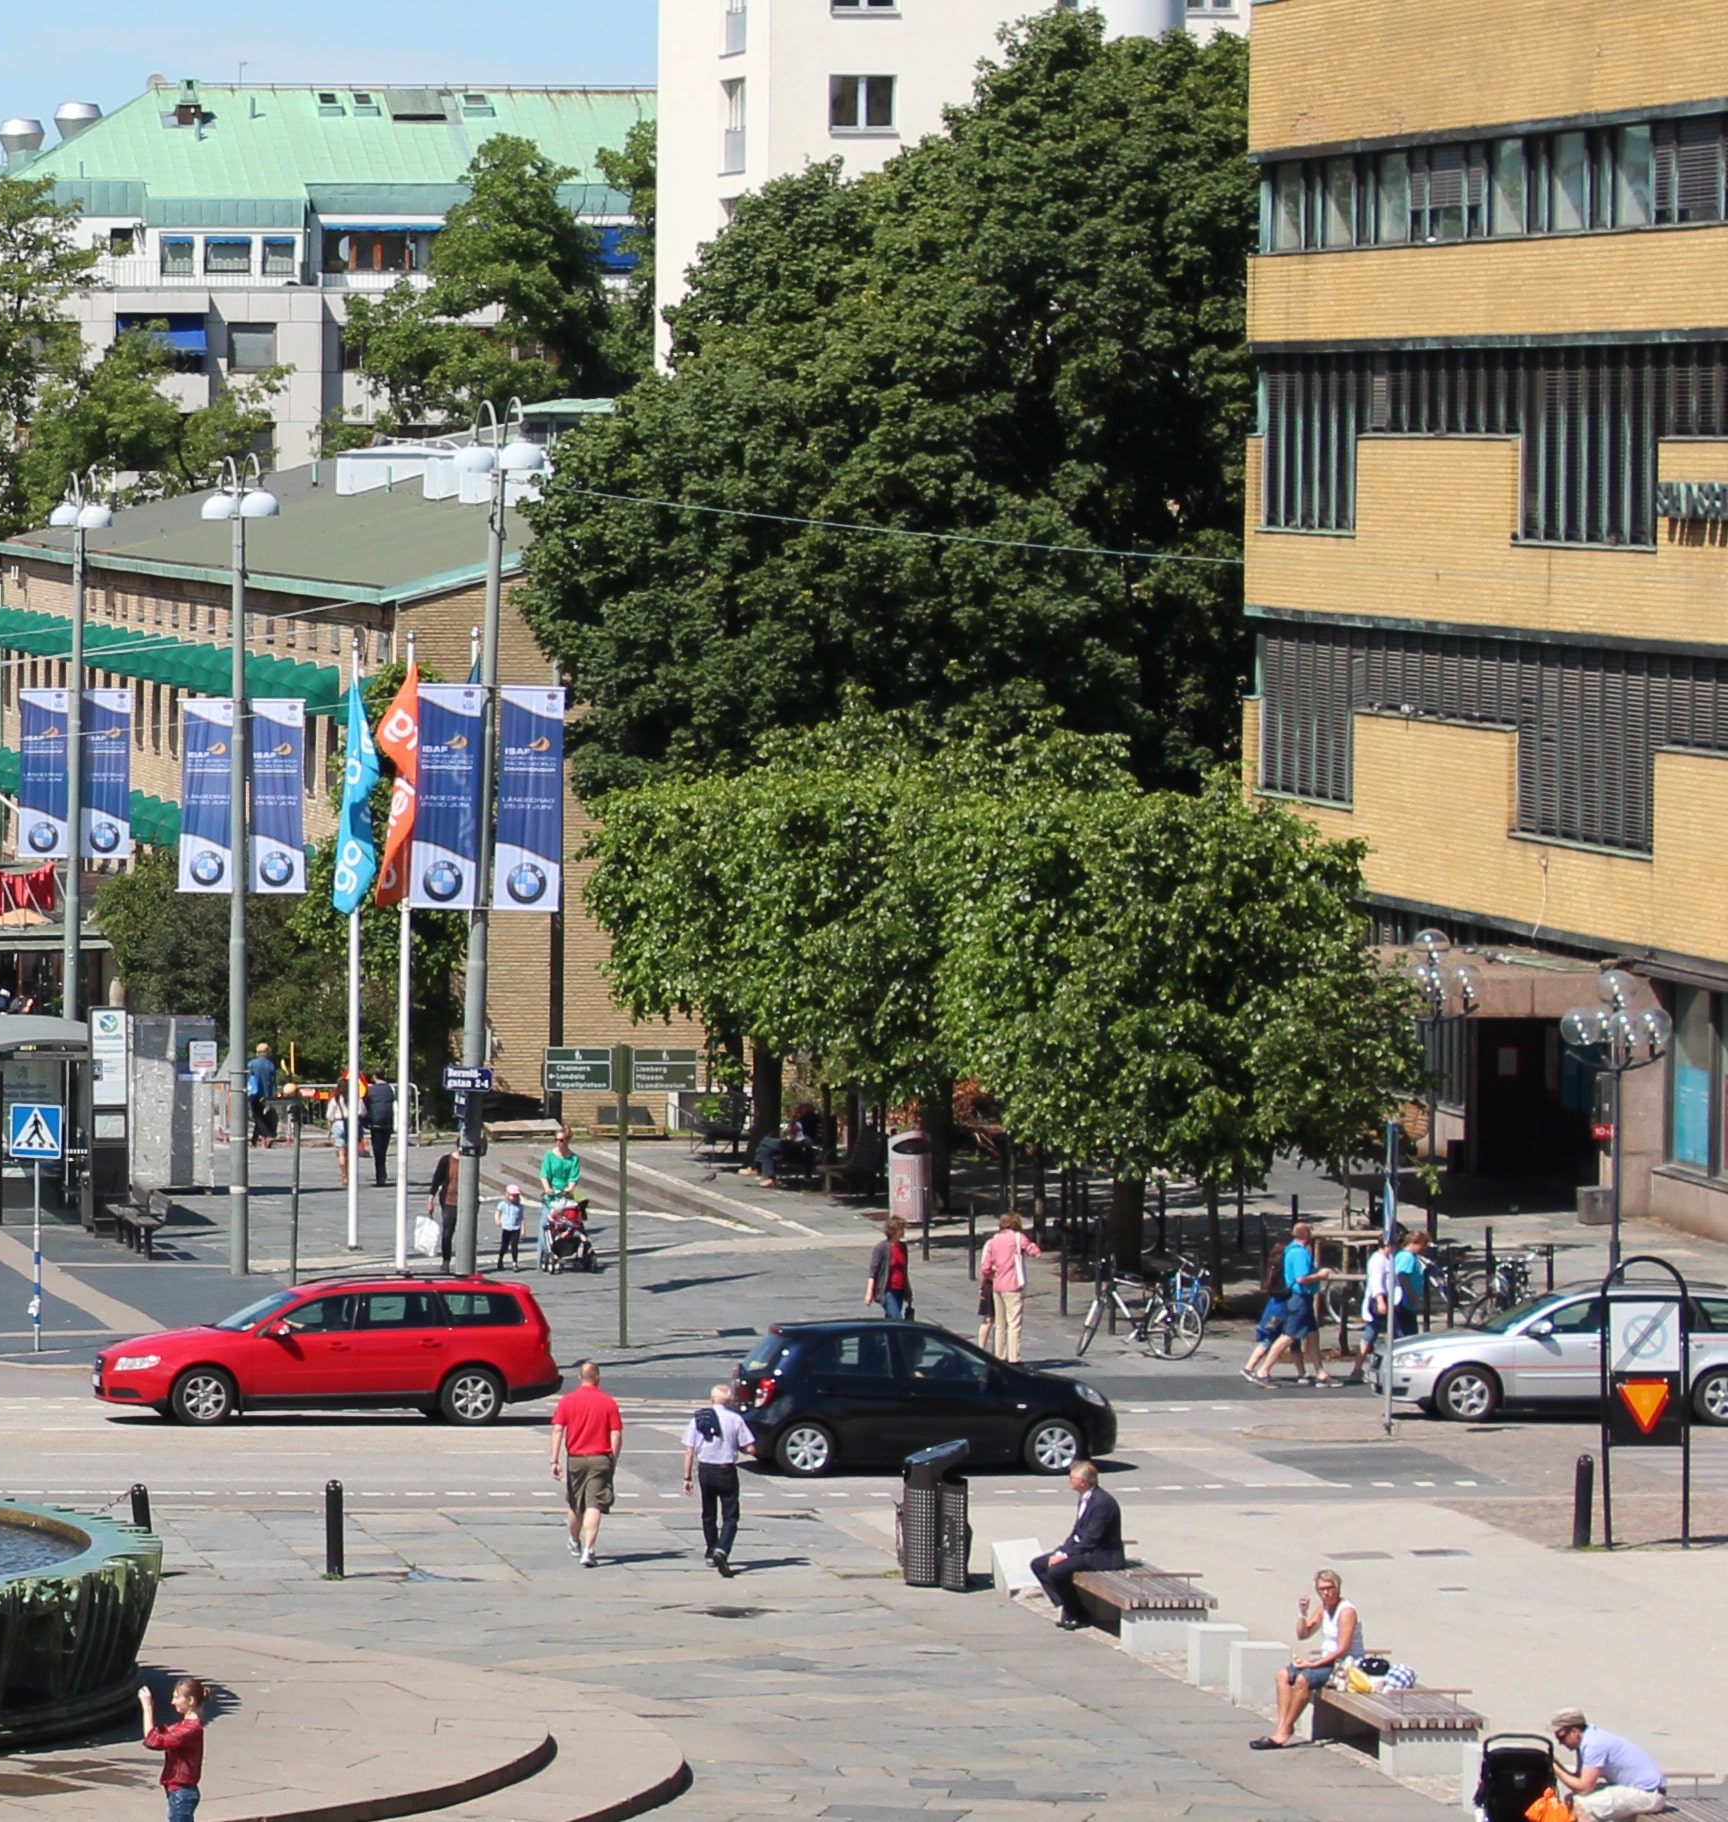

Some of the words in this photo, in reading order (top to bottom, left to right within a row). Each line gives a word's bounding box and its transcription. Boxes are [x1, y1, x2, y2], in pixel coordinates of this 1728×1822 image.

[636, 1066, 667, 1074] Liseberg
[447, 1079, 472, 1088] gatan
[474, 1079, 489, 1088] 2-4
